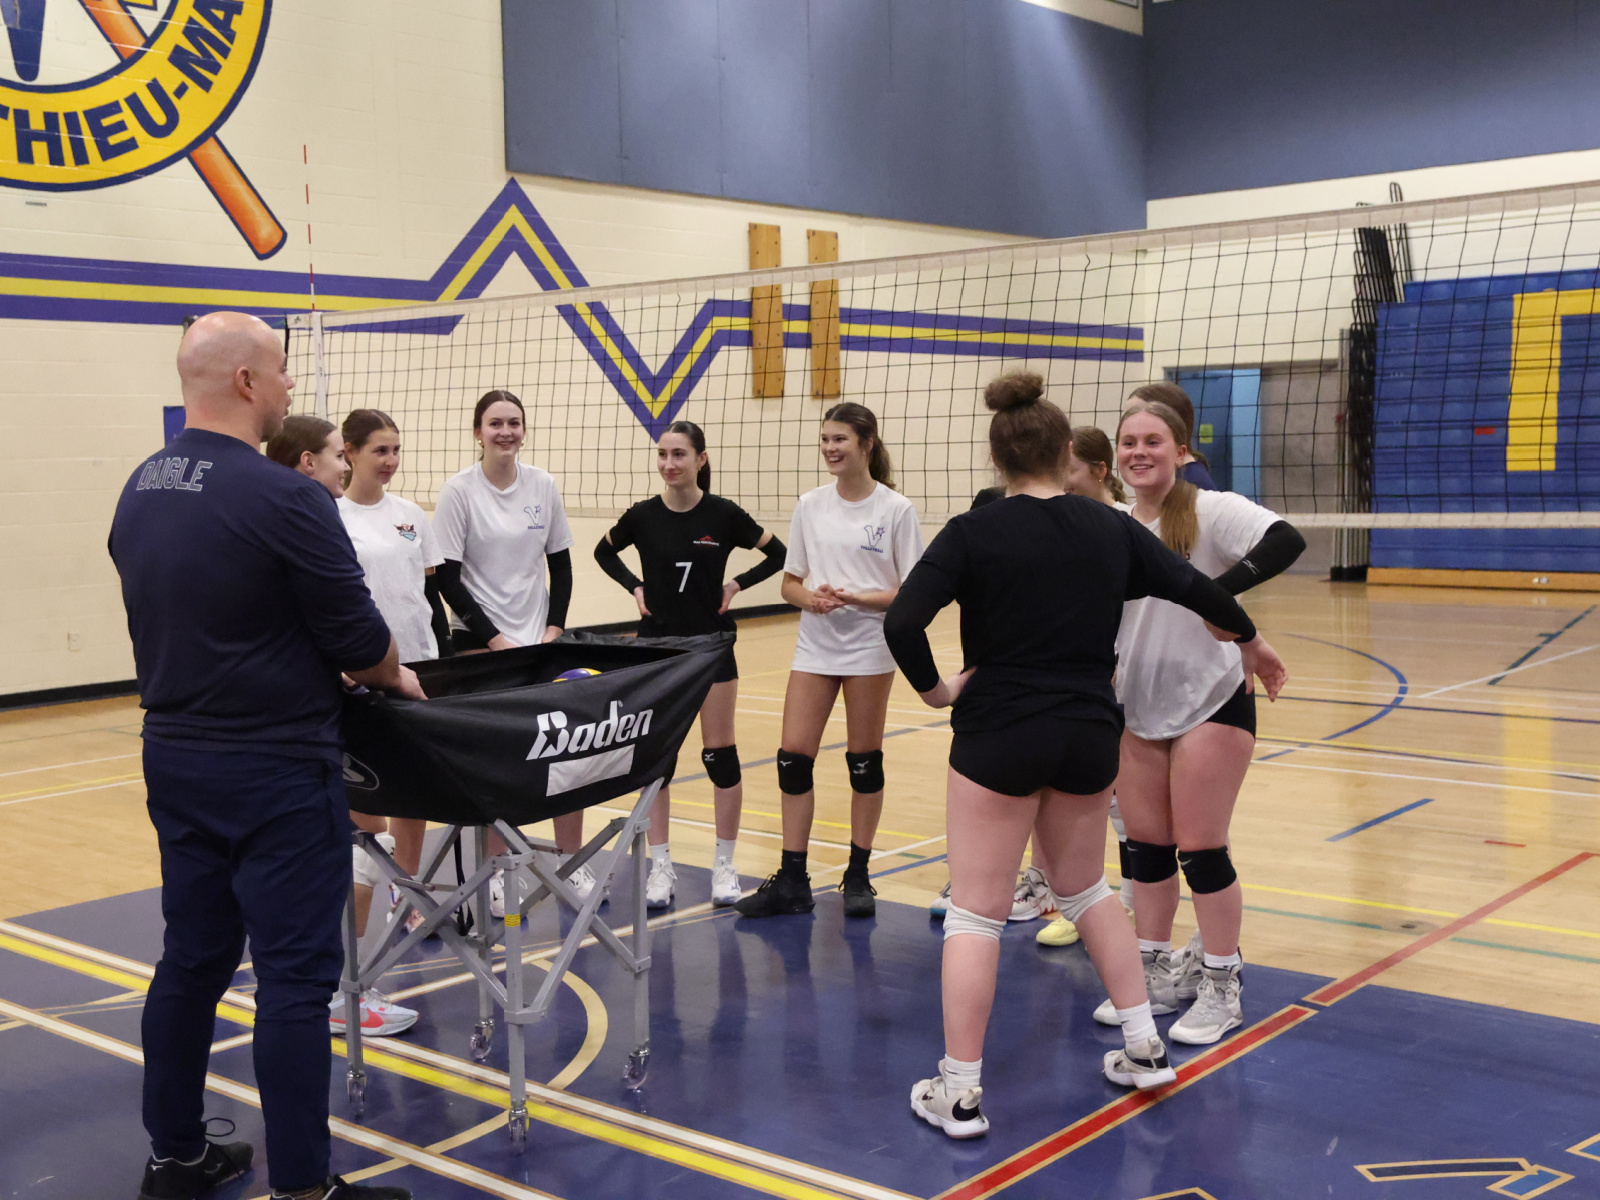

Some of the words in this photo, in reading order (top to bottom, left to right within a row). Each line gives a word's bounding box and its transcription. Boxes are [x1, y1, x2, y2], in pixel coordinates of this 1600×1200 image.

[136, 457, 213, 491] DAIGLE
[675, 562, 693, 592] 7
[525, 700, 653, 760] Baden
